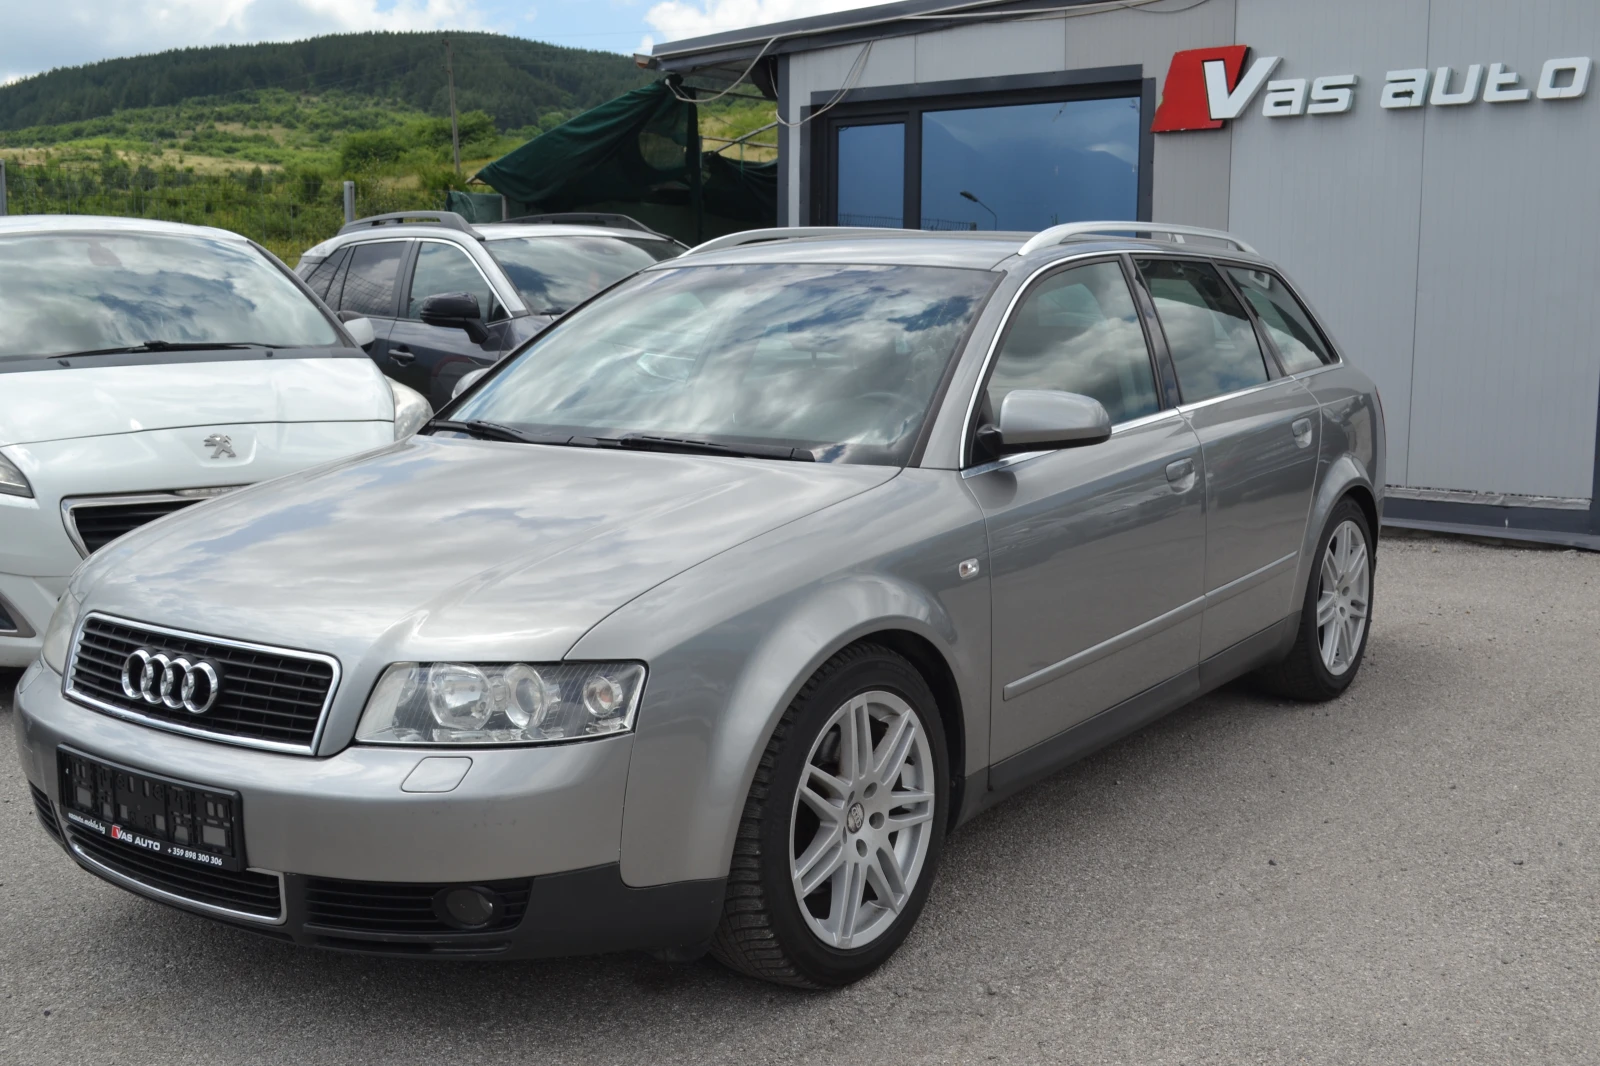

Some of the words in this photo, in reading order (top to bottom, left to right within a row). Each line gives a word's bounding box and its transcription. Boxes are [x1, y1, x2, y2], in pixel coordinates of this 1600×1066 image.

[1202, 56, 1359, 120] Vas
[1379, 56, 1593, 109] auto
[116, 828, 133, 843] VAS
[134, 836, 161, 851] AUTO
[172, 847, 184, 857] 359
[184, 850, 197, 860] 898
[197, 853, 210, 863] 300
[210, 856, 223, 866] 306
